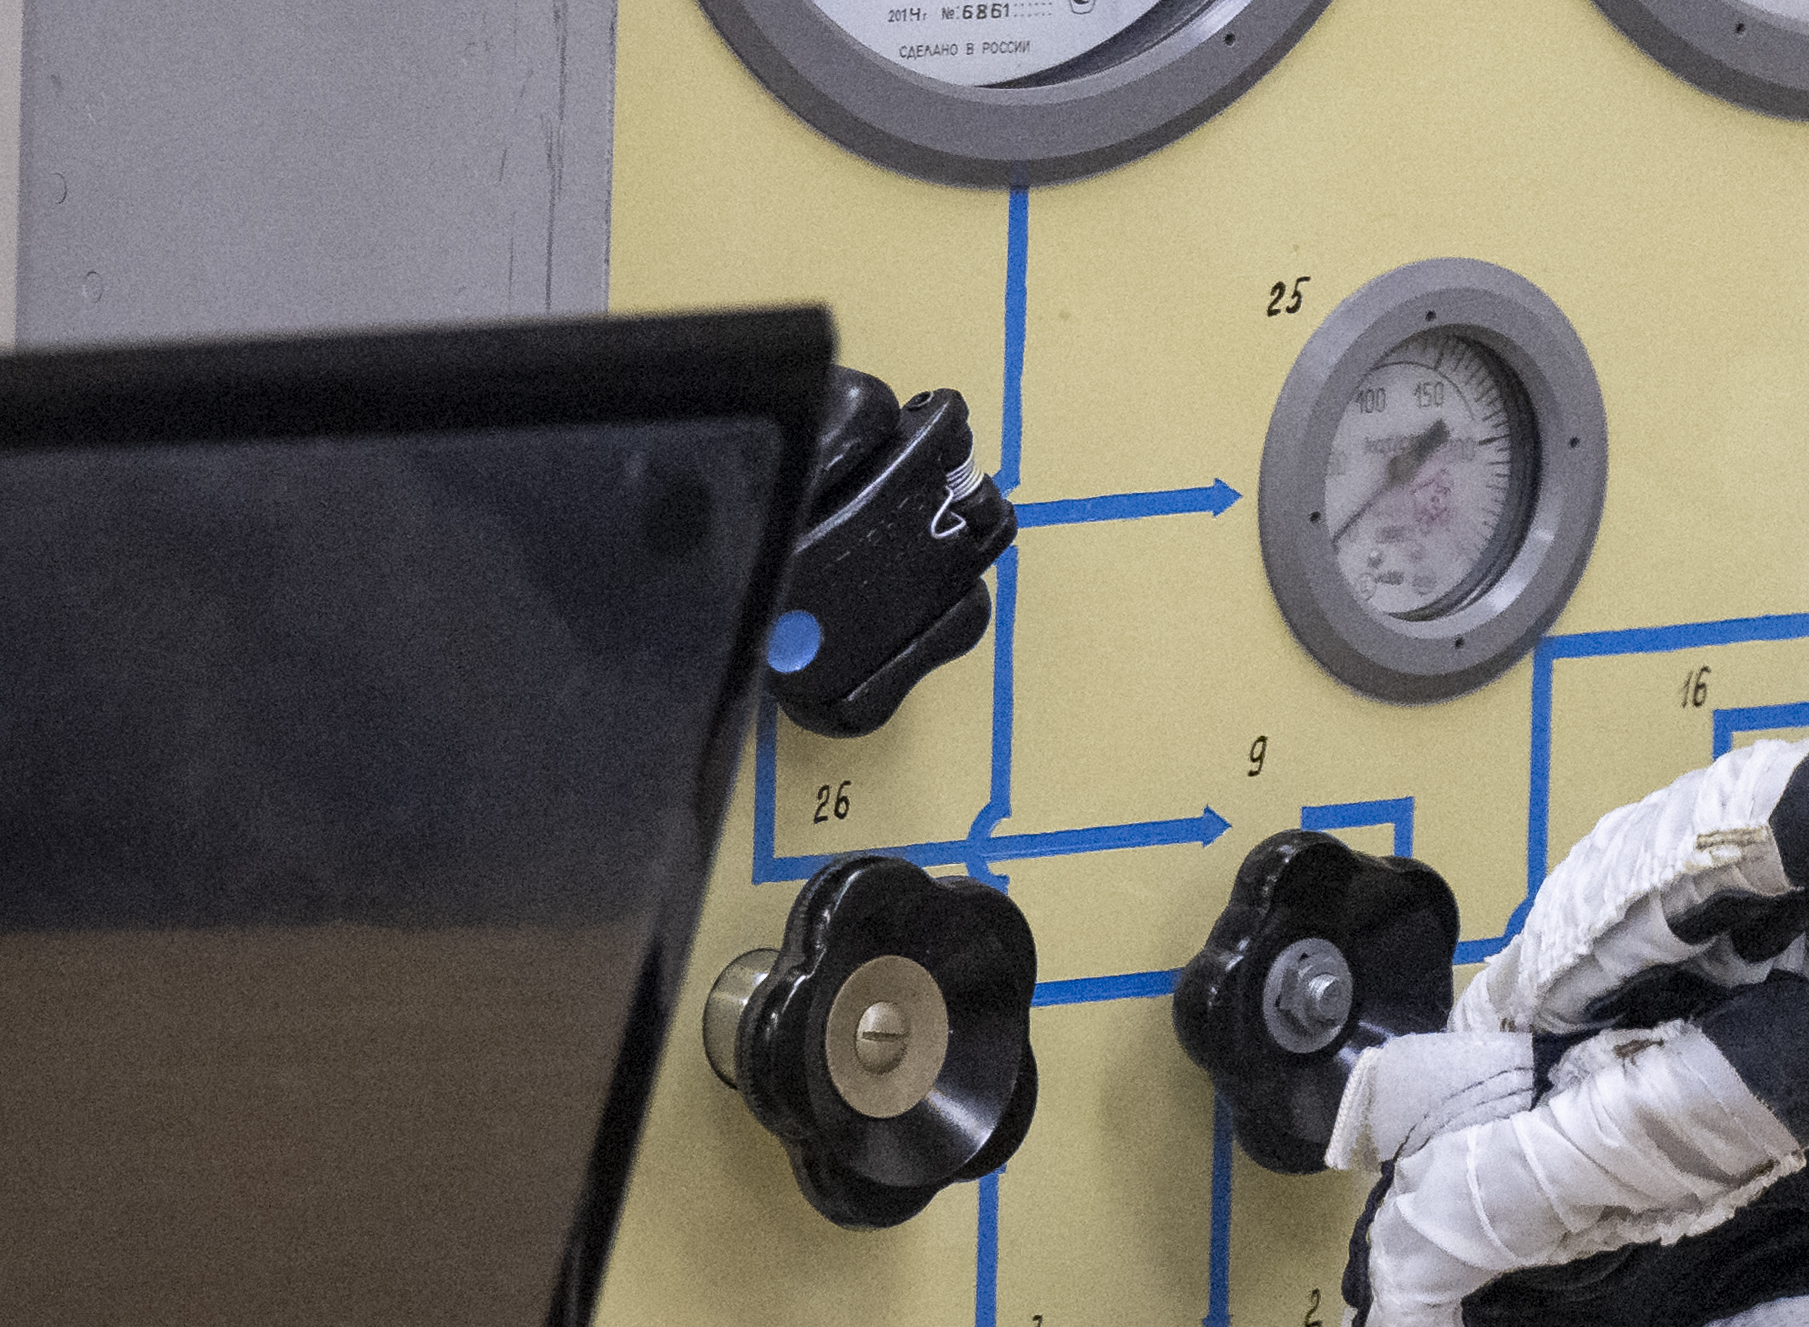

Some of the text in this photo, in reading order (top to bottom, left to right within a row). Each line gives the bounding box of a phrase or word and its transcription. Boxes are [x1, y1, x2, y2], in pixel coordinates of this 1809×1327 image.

[898, 40, 1031, 60] СДЕЛАНО В РОССИИ
[1266, 275, 1311, 318] 25
[1681, 665, 1711, 709] 16
[1247, 734, 1268, 778] 9
[812, 779, 852, 825] 26
